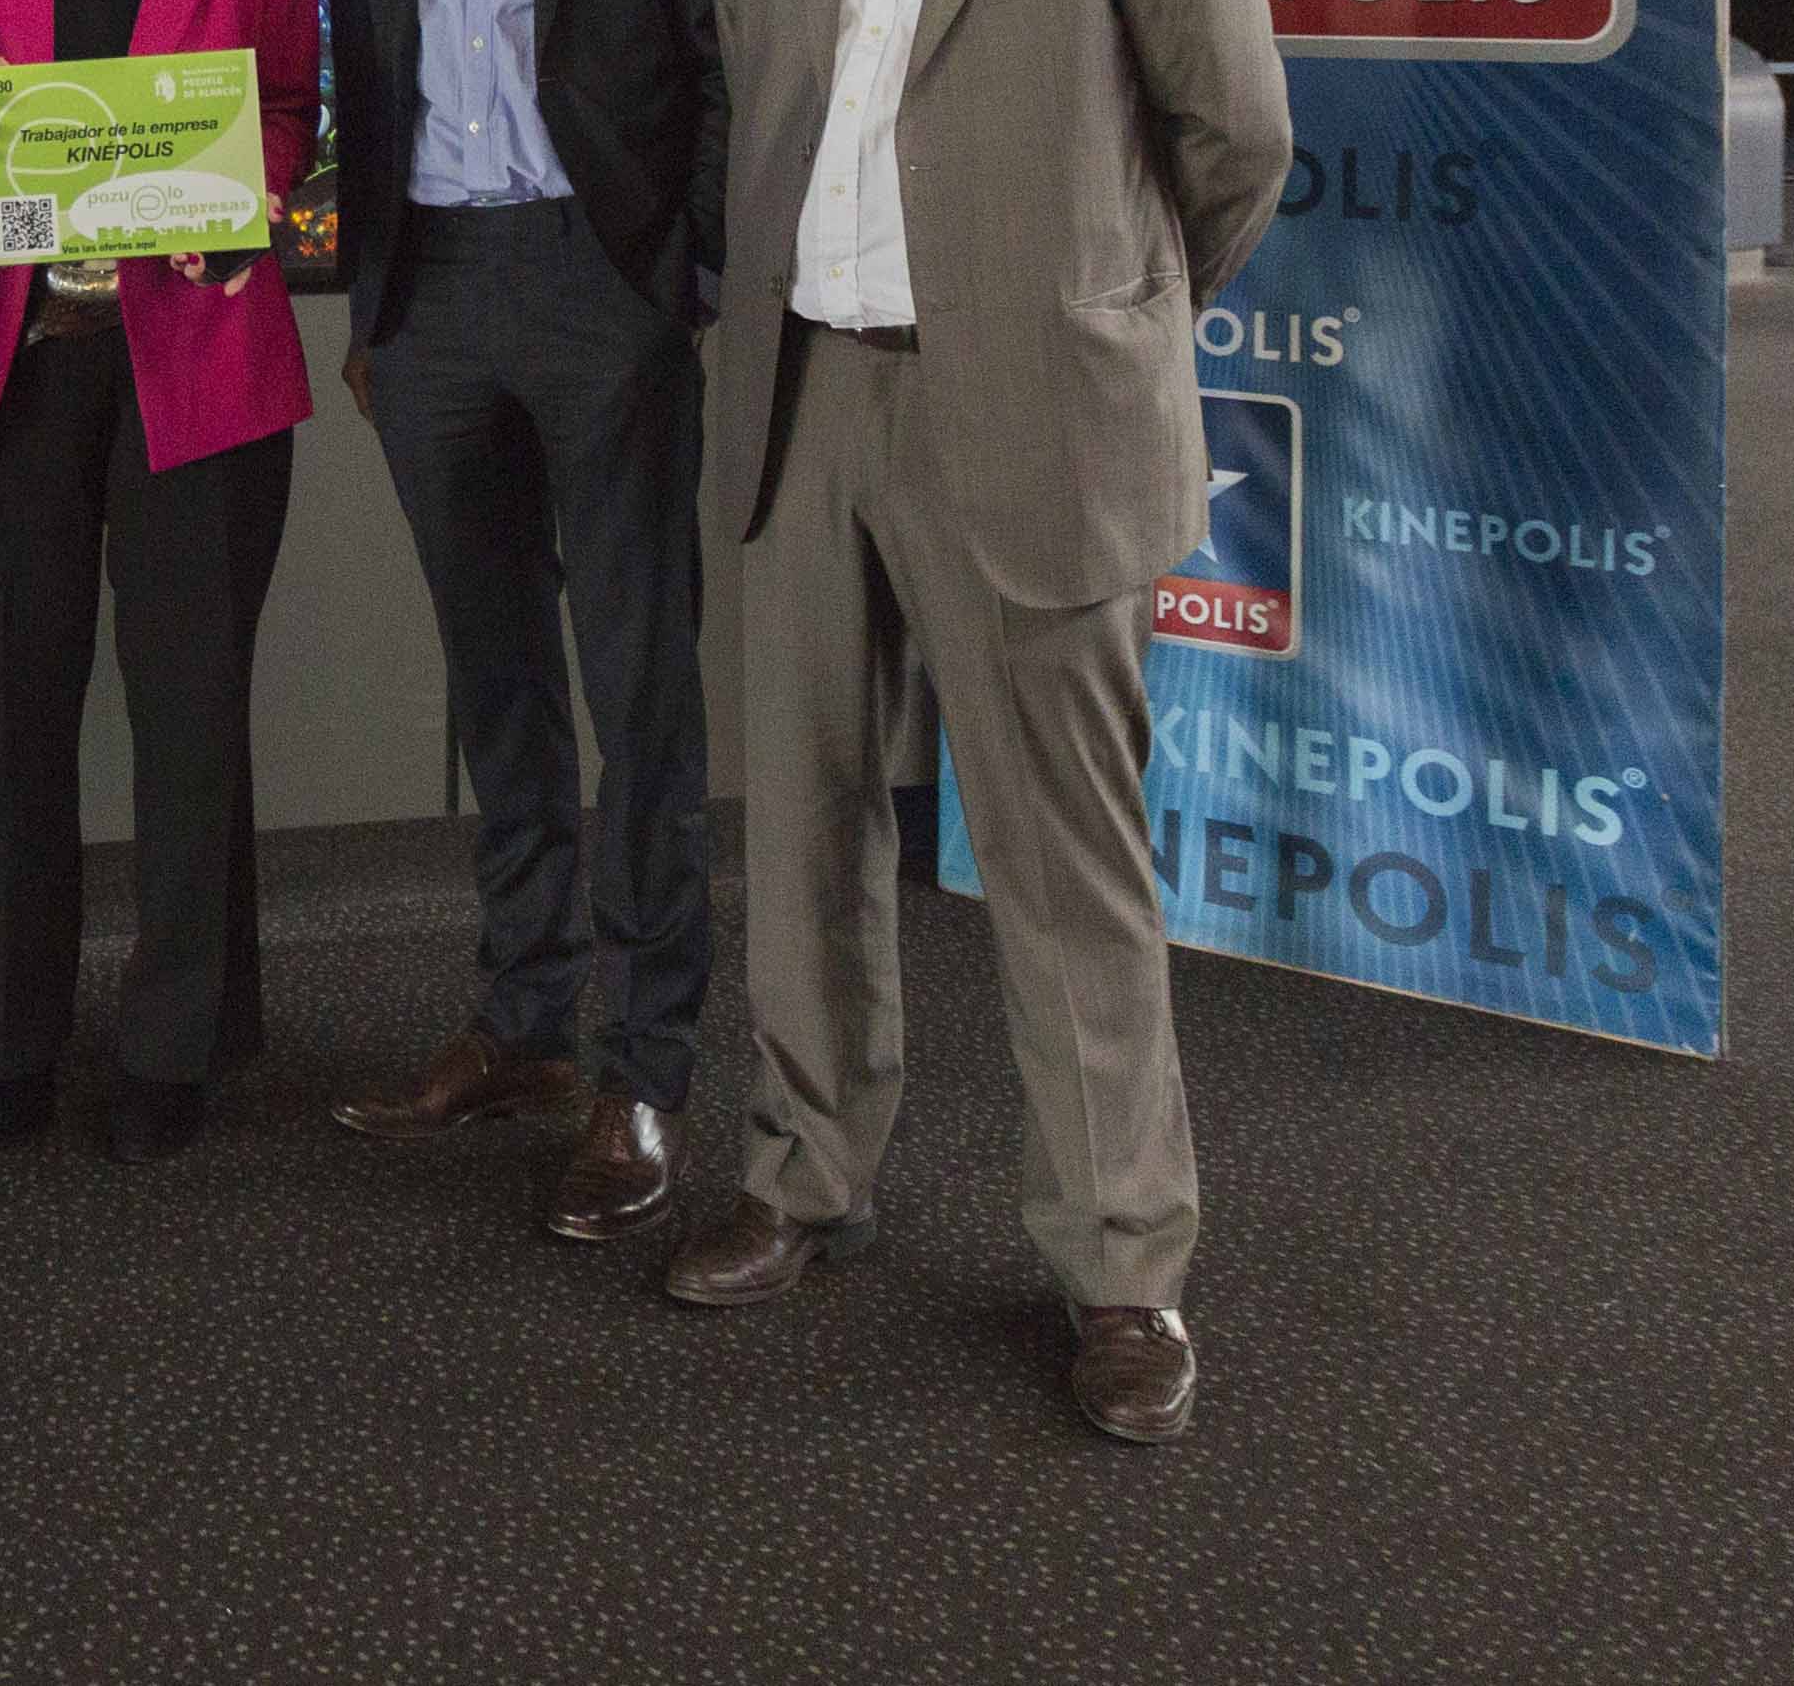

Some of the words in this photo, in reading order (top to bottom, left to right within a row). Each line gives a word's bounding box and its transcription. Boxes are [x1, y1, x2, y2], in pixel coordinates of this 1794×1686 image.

[20, 126, 104, 143] Trabajador
[108, 123, 127, 137] de
[131, 122, 145, 135] la
[150, 119, 218, 137] empresa
[67, 140, 174, 164] KINÉPOLIS
[1343, 497, 1655, 576] KINEPOLIS
[1157, 590, 1269, 634] POLIS
